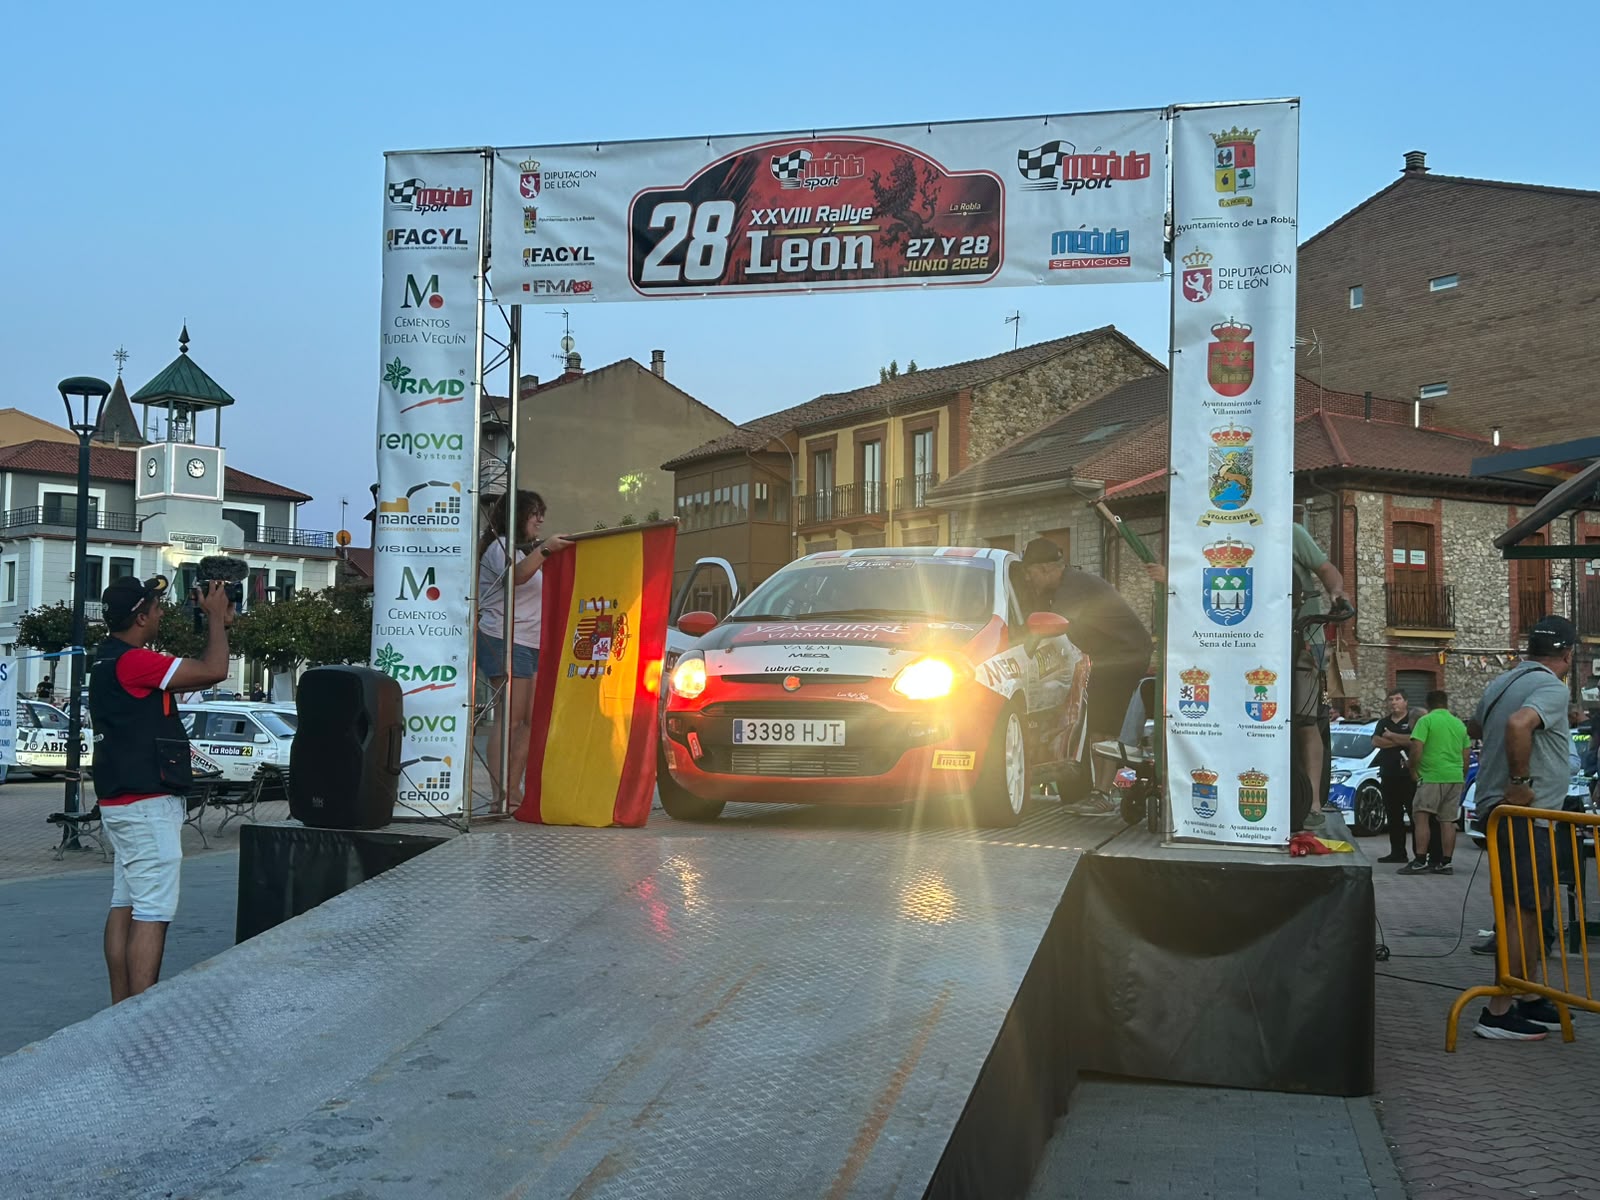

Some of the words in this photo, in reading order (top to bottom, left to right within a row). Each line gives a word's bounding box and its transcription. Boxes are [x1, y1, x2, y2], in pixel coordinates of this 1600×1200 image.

[544, 170, 596, 180] DIPUTACIÓN
[544, 181, 554, 189] DE
[558, 178, 580, 188] LEÓN
[804, 176, 838, 191] sport
[1060, 174, 1112, 196] sport
[414, 204, 448, 216] sport
[960, 202, 981, 210] Robla
[748, 206, 812, 226] XXVIII
[815, 204, 873, 224] Rallye
[1176, 220, 1240, 234] Ayuntamiento
[1242, 219, 1254, 228] de
[1256, 218, 1268, 226] La
[1270, 216, 1296, 225] Robla
[394, 228, 468, 246] FACYL
[640, 200, 736, 282] 28
[744, 227, 874, 274] León
[906, 238, 936, 258] 27
[941, 236, 956, 256] Y
[960, 235, 990, 254] 28
[532, 246, 594, 262] FACYL
[904, 258, 948, 272] JUNIO
[952, 256, 989, 270] 2026
[1052, 258, 1128, 268] SERVICIOS
[1218, 262, 1292, 278] DIPUTACIÓN
[1218, 280, 1234, 290] DE
[1238, 276, 1269, 290] LEÓN
[394, 316, 450, 328] CEMENTOS
[384, 333, 418, 345] TUDELA
[422, 332, 466, 345] VEGUÍN
[400, 378, 465, 396] RMD
[1202, 400, 1252, 408] Ayuntamiento
[379, 432, 463, 455] renova
[416, 452, 462, 460] Systems
[377, 546, 461, 554] VISIOLUXE
[388, 608, 447, 620] CEMENTOS
[376, 624, 414, 636] TUDELA
[418, 624, 462, 637] VEGUÍN
[1192, 630, 1251, 640] Ayuntamiento
[1254, 630, 1264, 638] de
[1200, 640, 1220, 648] Sena
[1222, 640, 1232, 648] de
[1234, 640, 1256, 648] Luna
[392, 664, 457, 682] RMD
[402, 715, 456, 737] ova
[746, 722, 796, 742] 3398
[802, 723, 840, 742] HJT
[411, 734, 454, 743] Systems
[210, 745, 219, 754] La
[220, 746, 240, 755] Robla
[242, 746, 252, 756] 23
